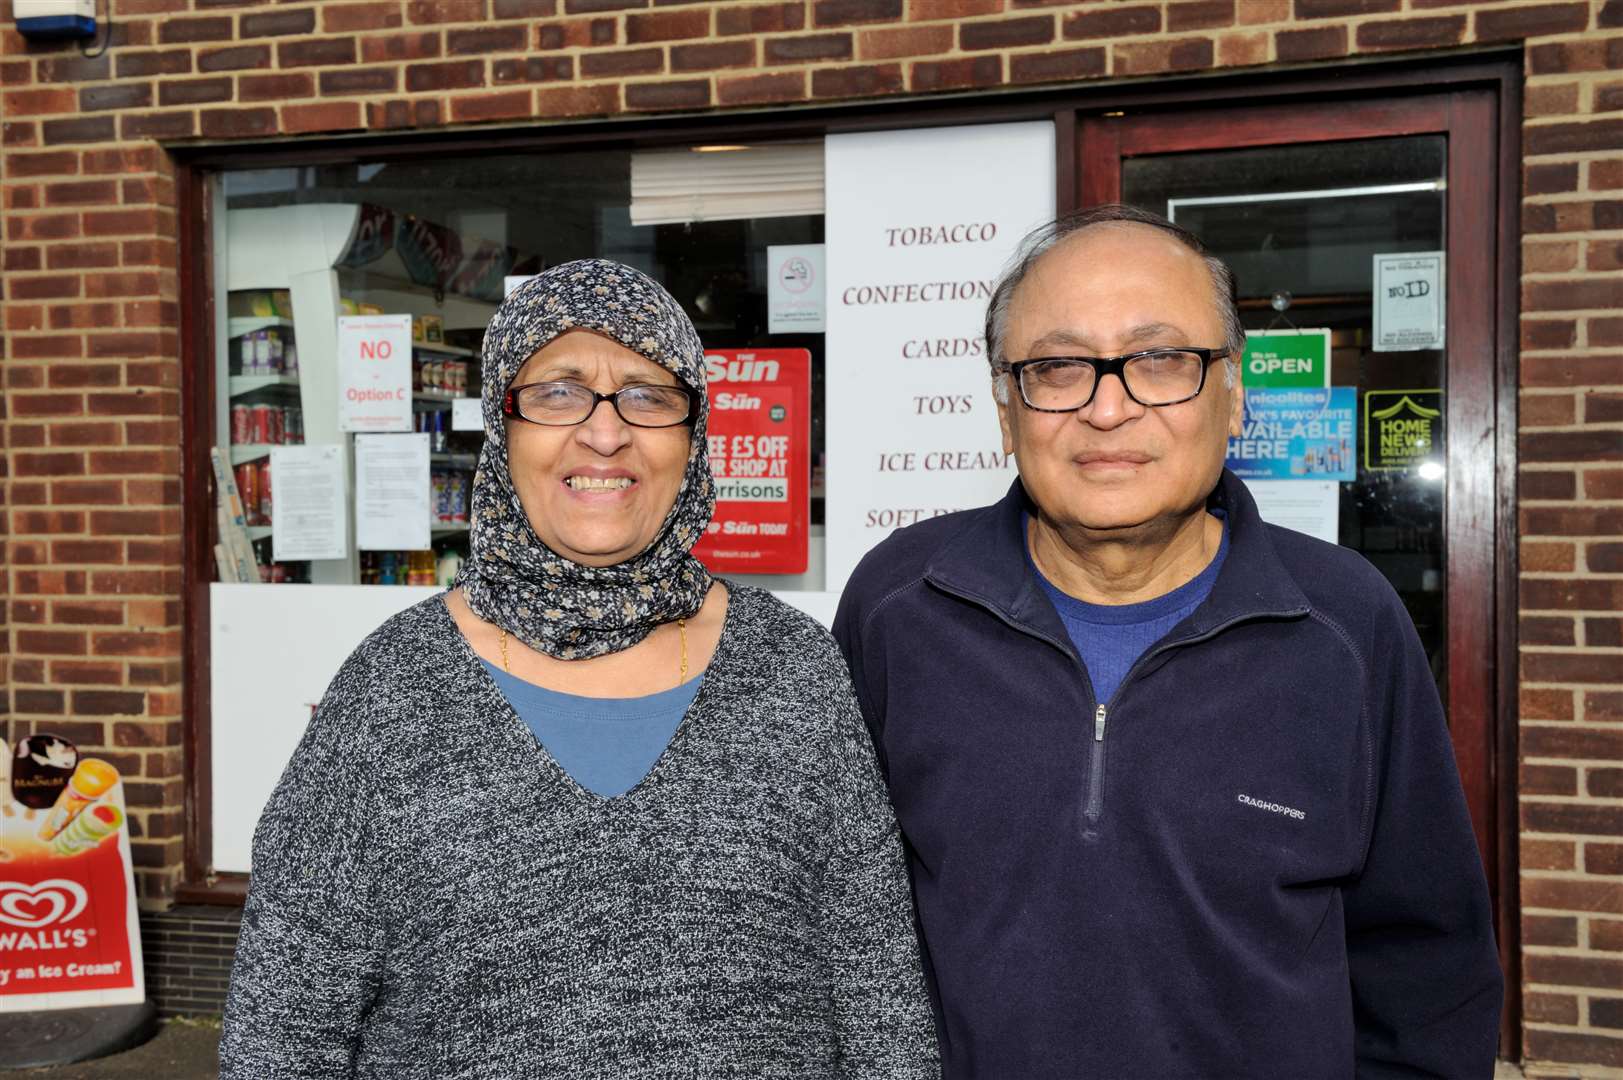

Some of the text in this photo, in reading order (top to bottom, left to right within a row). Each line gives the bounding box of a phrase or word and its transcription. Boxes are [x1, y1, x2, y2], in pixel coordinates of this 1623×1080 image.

[886, 222, 997, 247] TOBACCO
[360, 340, 392, 360] NO
[902, 338, 982, 359] CARDS
[704, 355, 780, 382] Sun
[1249, 358, 1313, 374] OPEN
[346, 387, 405, 404] Option C
[714, 392, 761, 410] Sun
[914, 394, 972, 415] TOYS
[1281, 409, 1353, 421] FAVOURITE
[1237, 421, 1353, 440] VAILABLE
[1381, 419, 1431, 434] HOME
[730, 435, 755, 458] £5
[757, 435, 788, 458] OFF
[1225, 440, 1288, 459] HERE
[1381, 433, 1432, 449] NEWS
[729, 458, 769, 477] SHOP
[769, 459, 788, 477] AT
[878, 451, 1009, 473] ICE CREAM
[716, 480, 785, 498] rrisons
[865, 508, 924, 528] SOFT
[1237, 793, 1306, 820] CRAGHOPPERS
[15, 967, 35, 979] an
[38, 965, 63, 978] Ice
[66, 960, 122, 977] Cream?
